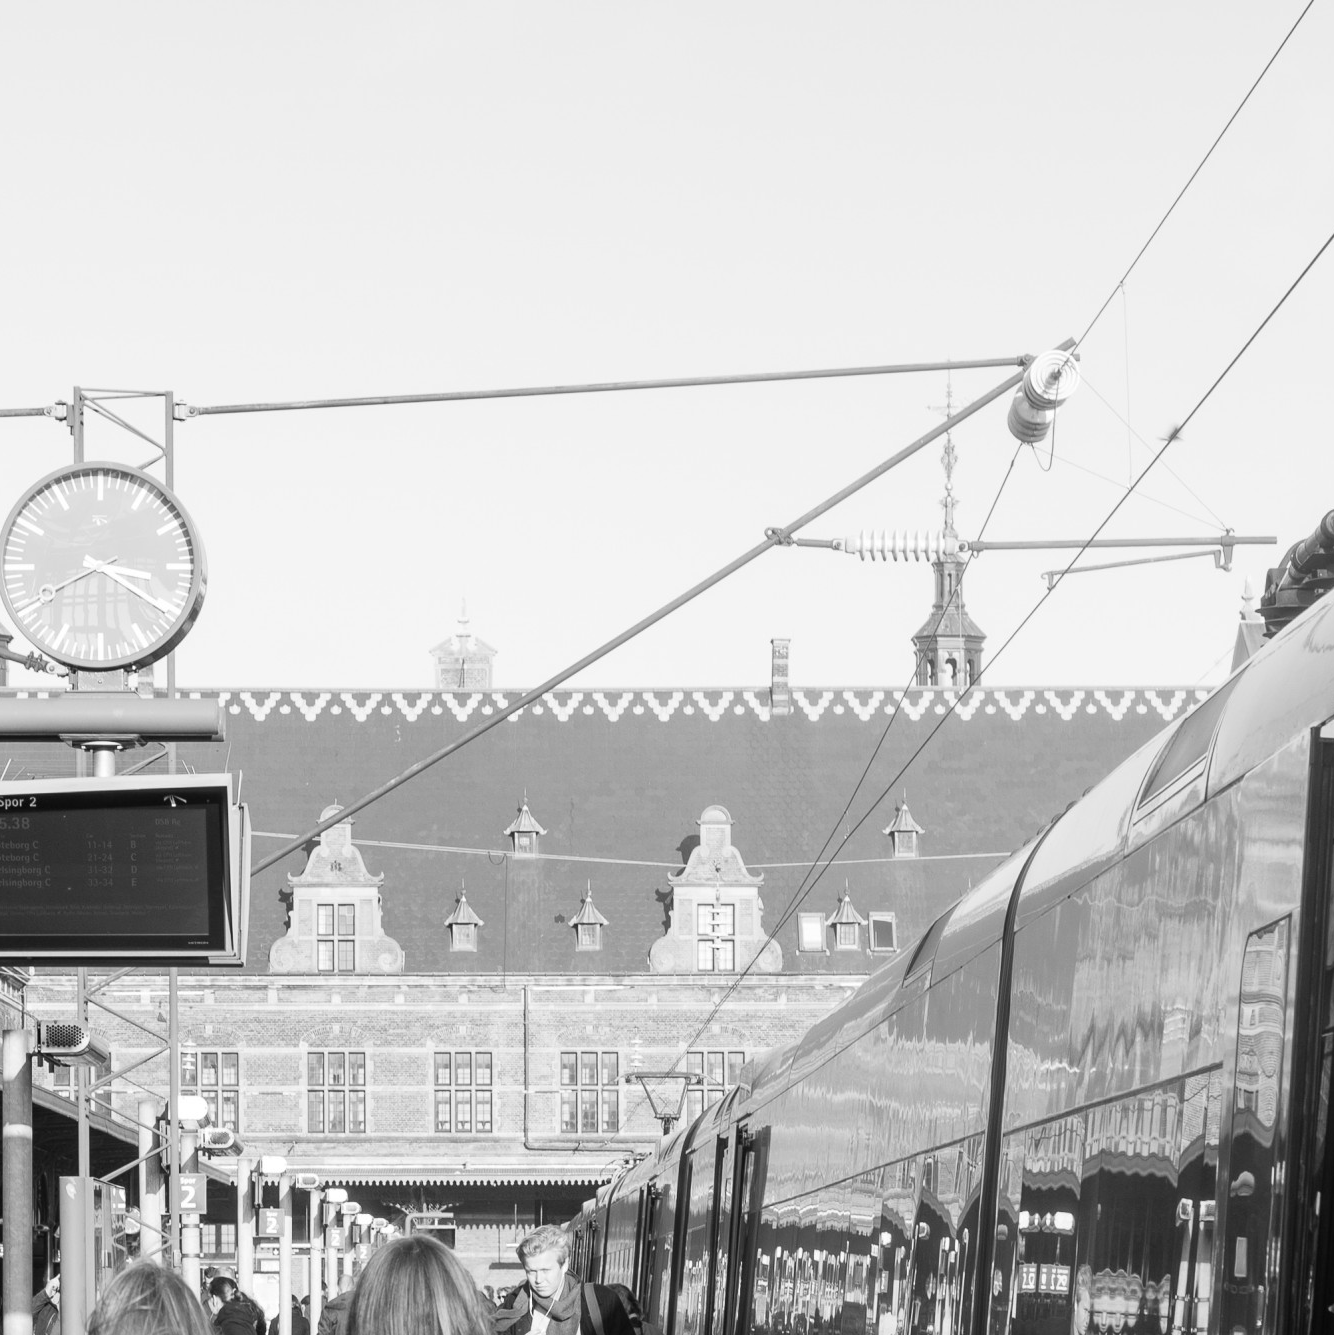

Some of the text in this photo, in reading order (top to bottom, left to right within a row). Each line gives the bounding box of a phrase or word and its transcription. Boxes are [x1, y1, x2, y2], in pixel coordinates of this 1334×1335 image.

[30, 797, 37, 807] 2
[32, 840, 39, 849] C
[87, 840, 113, 849] 11-14
[130, 840, 137, 849] B
[33, 853, 39, 861] C
[87, 853, 113, 862] 21-24
[130, 853, 137, 862] C
[44, 865, 51, 874] C
[131, 865, 138, 874] D
[45, 878, 51, 887] C
[131, 878, 138, 887] E
[181, 1185, 196, 1208] 2
[266, 1218, 277, 1234] 2
[331, 1234, 340, 1246] 2
[360, 1248, 367, 1259] 2
